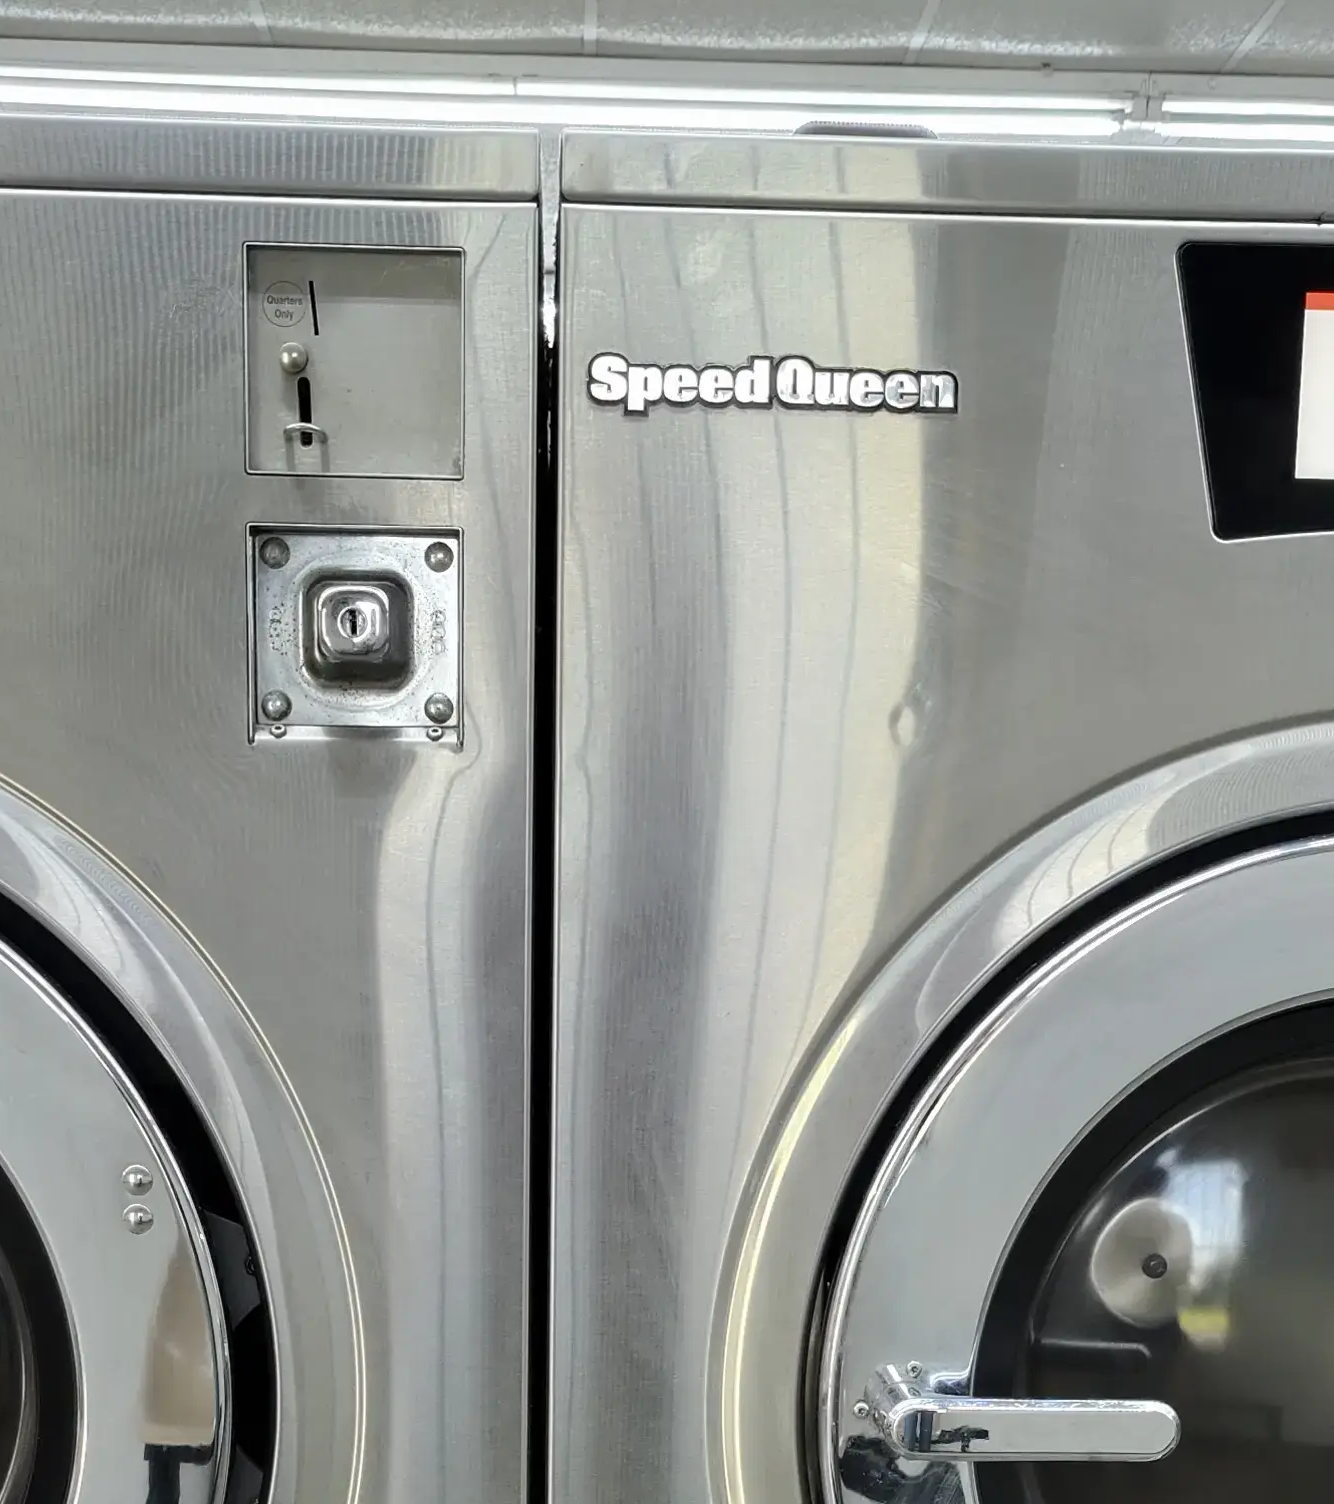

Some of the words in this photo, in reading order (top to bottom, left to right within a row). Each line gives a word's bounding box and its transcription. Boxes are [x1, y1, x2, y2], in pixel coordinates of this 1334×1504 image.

[266, 295, 303, 305] Quarters
[274, 308, 294, 321] Only
[588, 352, 773, 417] Speed
[774, 355, 958, 414] Queen
